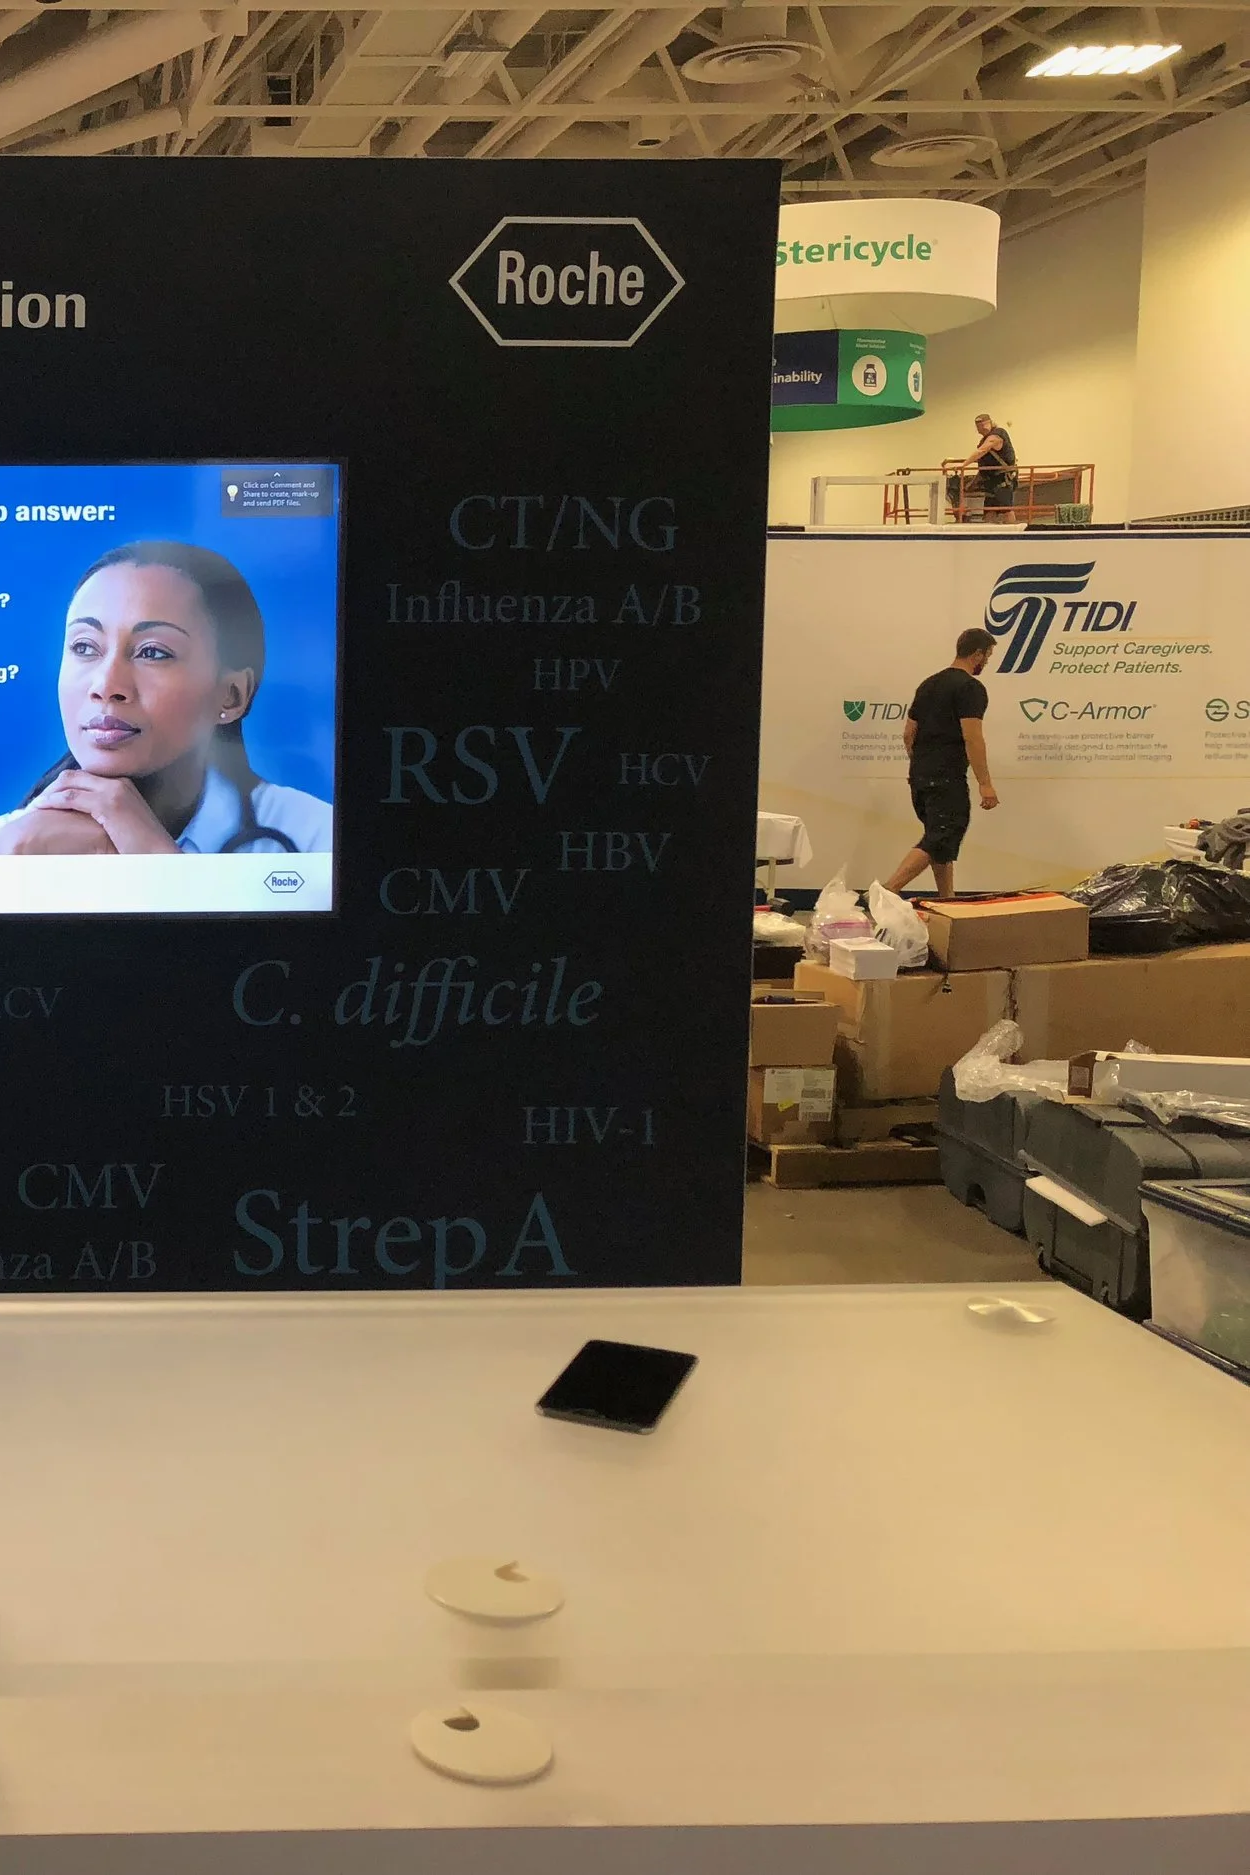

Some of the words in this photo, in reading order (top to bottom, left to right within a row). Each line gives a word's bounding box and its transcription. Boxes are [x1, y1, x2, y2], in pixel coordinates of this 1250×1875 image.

[776, 234, 932, 267] Stericycle
[498, 250, 646, 306] Roche
[243, 490, 260, 498] Share
[270, 481, 302, 489] Comment
[303, 481, 316, 489] and
[16, 506, 114, 521] answer:
[450, 495, 678, 551] CT/NG
[387, 580, 597, 623] Influenza
[612, 584, 701, 625] A/B
[1062, 600, 1138, 632] TIDI
[1053, 642, 1119, 658] Support
[1123, 641, 1212, 657] Caregivers.
[534, 659, 621, 690] HPV
[1048, 661, 1111, 674] Protect
[1113, 661, 1182, 674] Patients.
[869, 703, 908, 720] TIDI
[1050, 701, 1152, 720] C-Armor
[380, 725, 582, 805] RSV
[620, 753, 711, 785] HCV
[557, 832, 672, 873] HBV
[271, 876, 298, 887] Roche
[380, 868, 531, 914] CMV
[233, 960, 301, 1025] C.
[335, 956, 602, 1048] difficile
[162, 1085, 248, 1117] HSV
[267, 1087, 276, 1116] 1
[295, 1086, 325, 1117] &
[338, 1086, 356, 1116] 2
[523, 1107, 654, 1144] HIV-1
[18, 1163, 165, 1209] CMV
[234, 1189, 486, 1289] Strep
[495, 1193, 578, 1275] A
[71, 1241, 156, 1280] A/B
